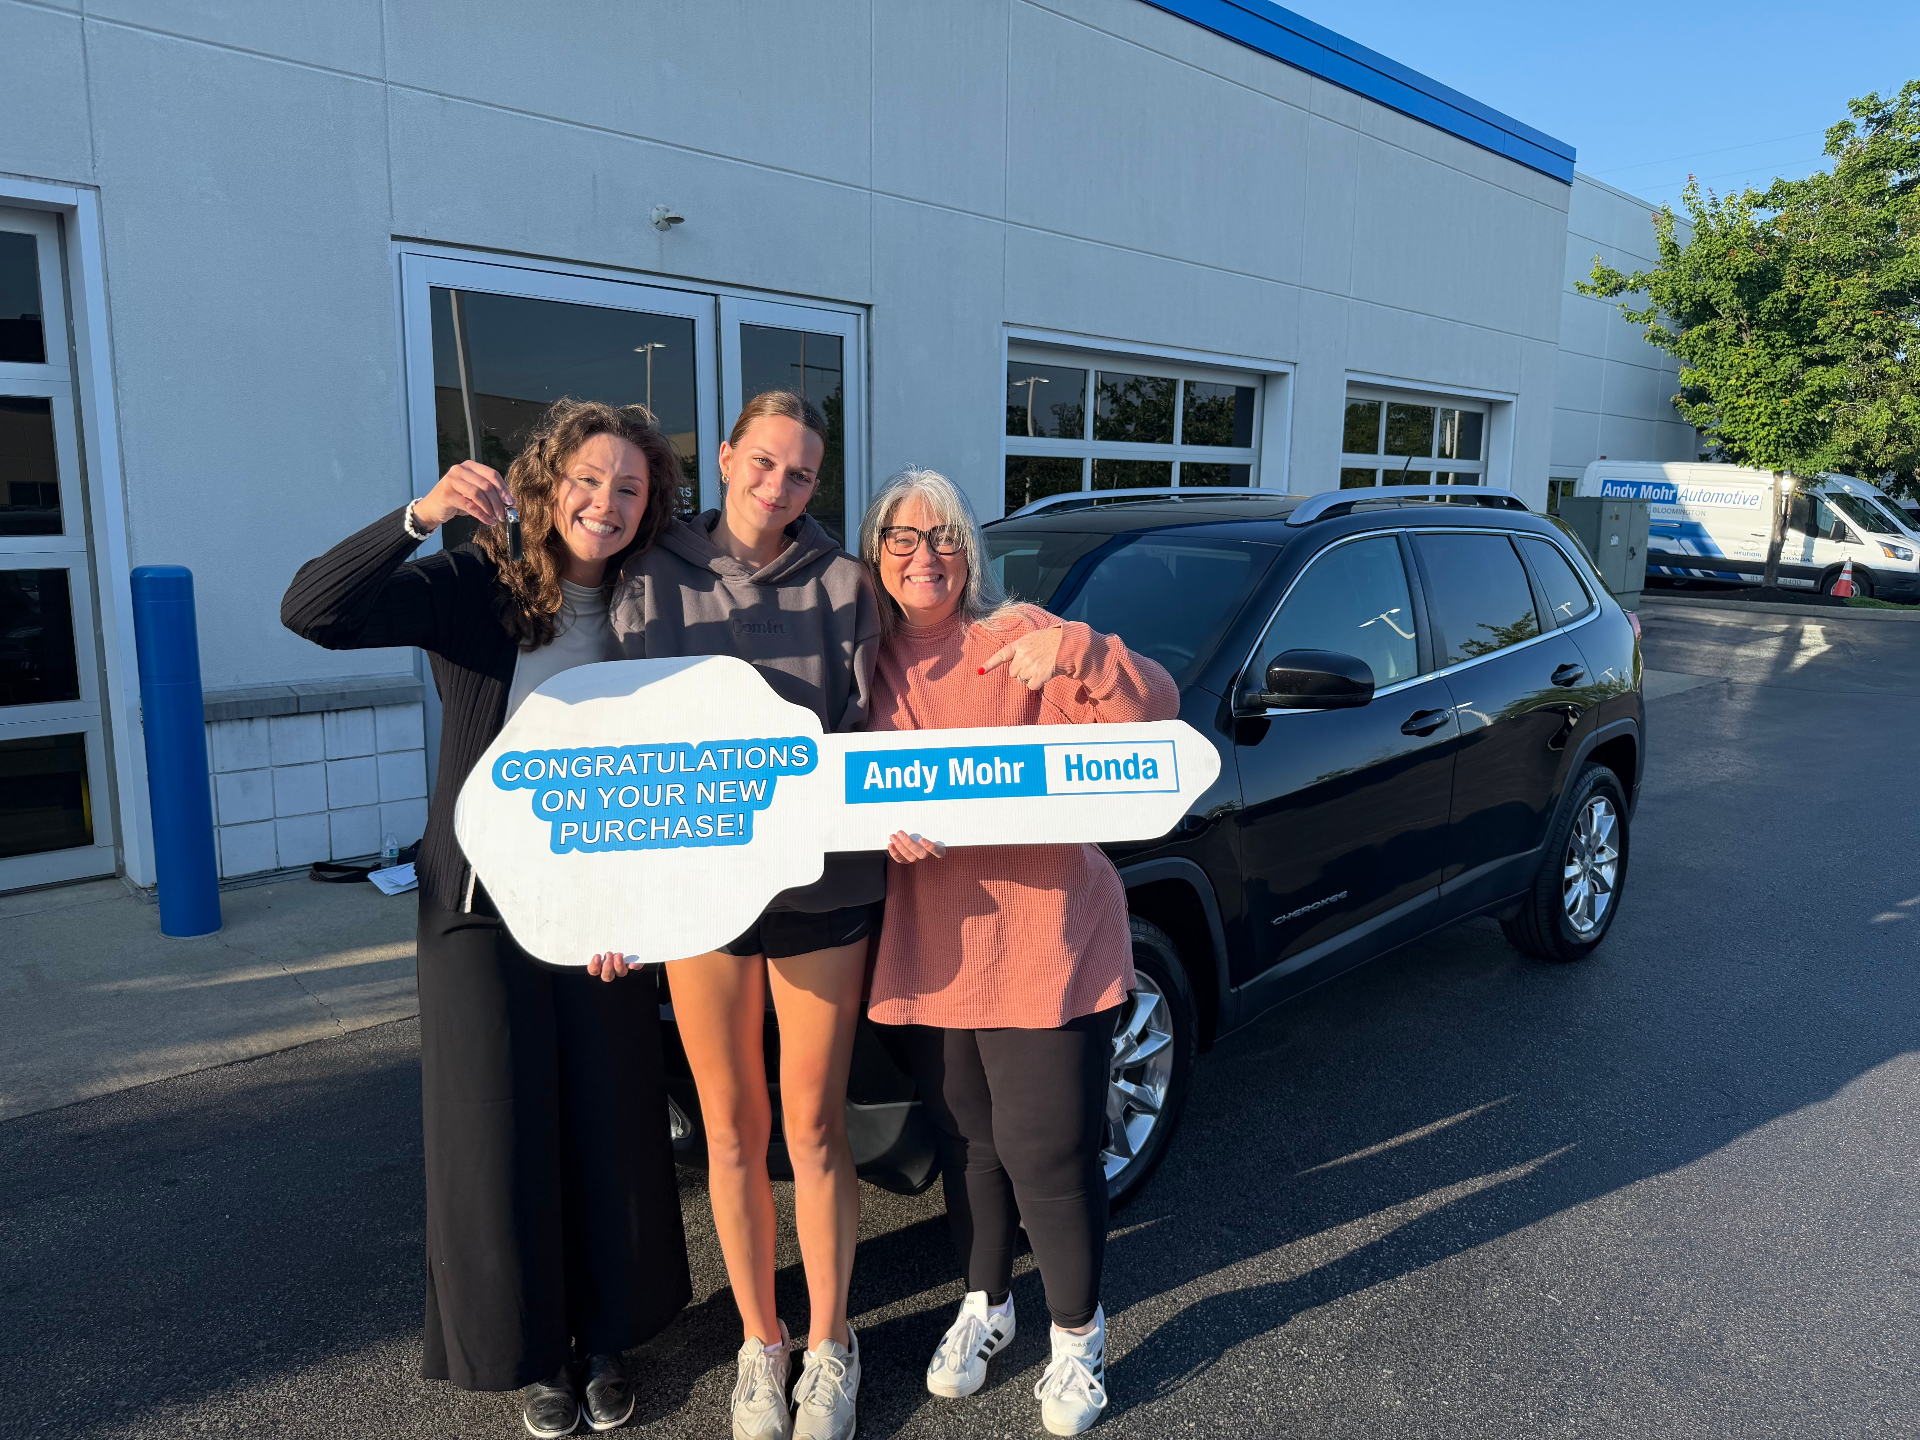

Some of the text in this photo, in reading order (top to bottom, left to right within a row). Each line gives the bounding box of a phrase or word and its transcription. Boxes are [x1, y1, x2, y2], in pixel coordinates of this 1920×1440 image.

[1602, 482, 1760, 506] Andy Mohr Automotive
[1652, 507, 1706, 517] BLOOMINGTON
[1733, 550, 1762, 558] HYUNDAI
[501, 744, 809, 783] CONGRATULATIONS
[863, 756, 1025, 793] Andy Mohr
[1064, 752, 1159, 782] Honda
[541, 779, 768, 812] ON YOUR NEW
[559, 813, 745, 845] PURCHASE!
[1272, 890, 1348, 926] CHEROKEE
